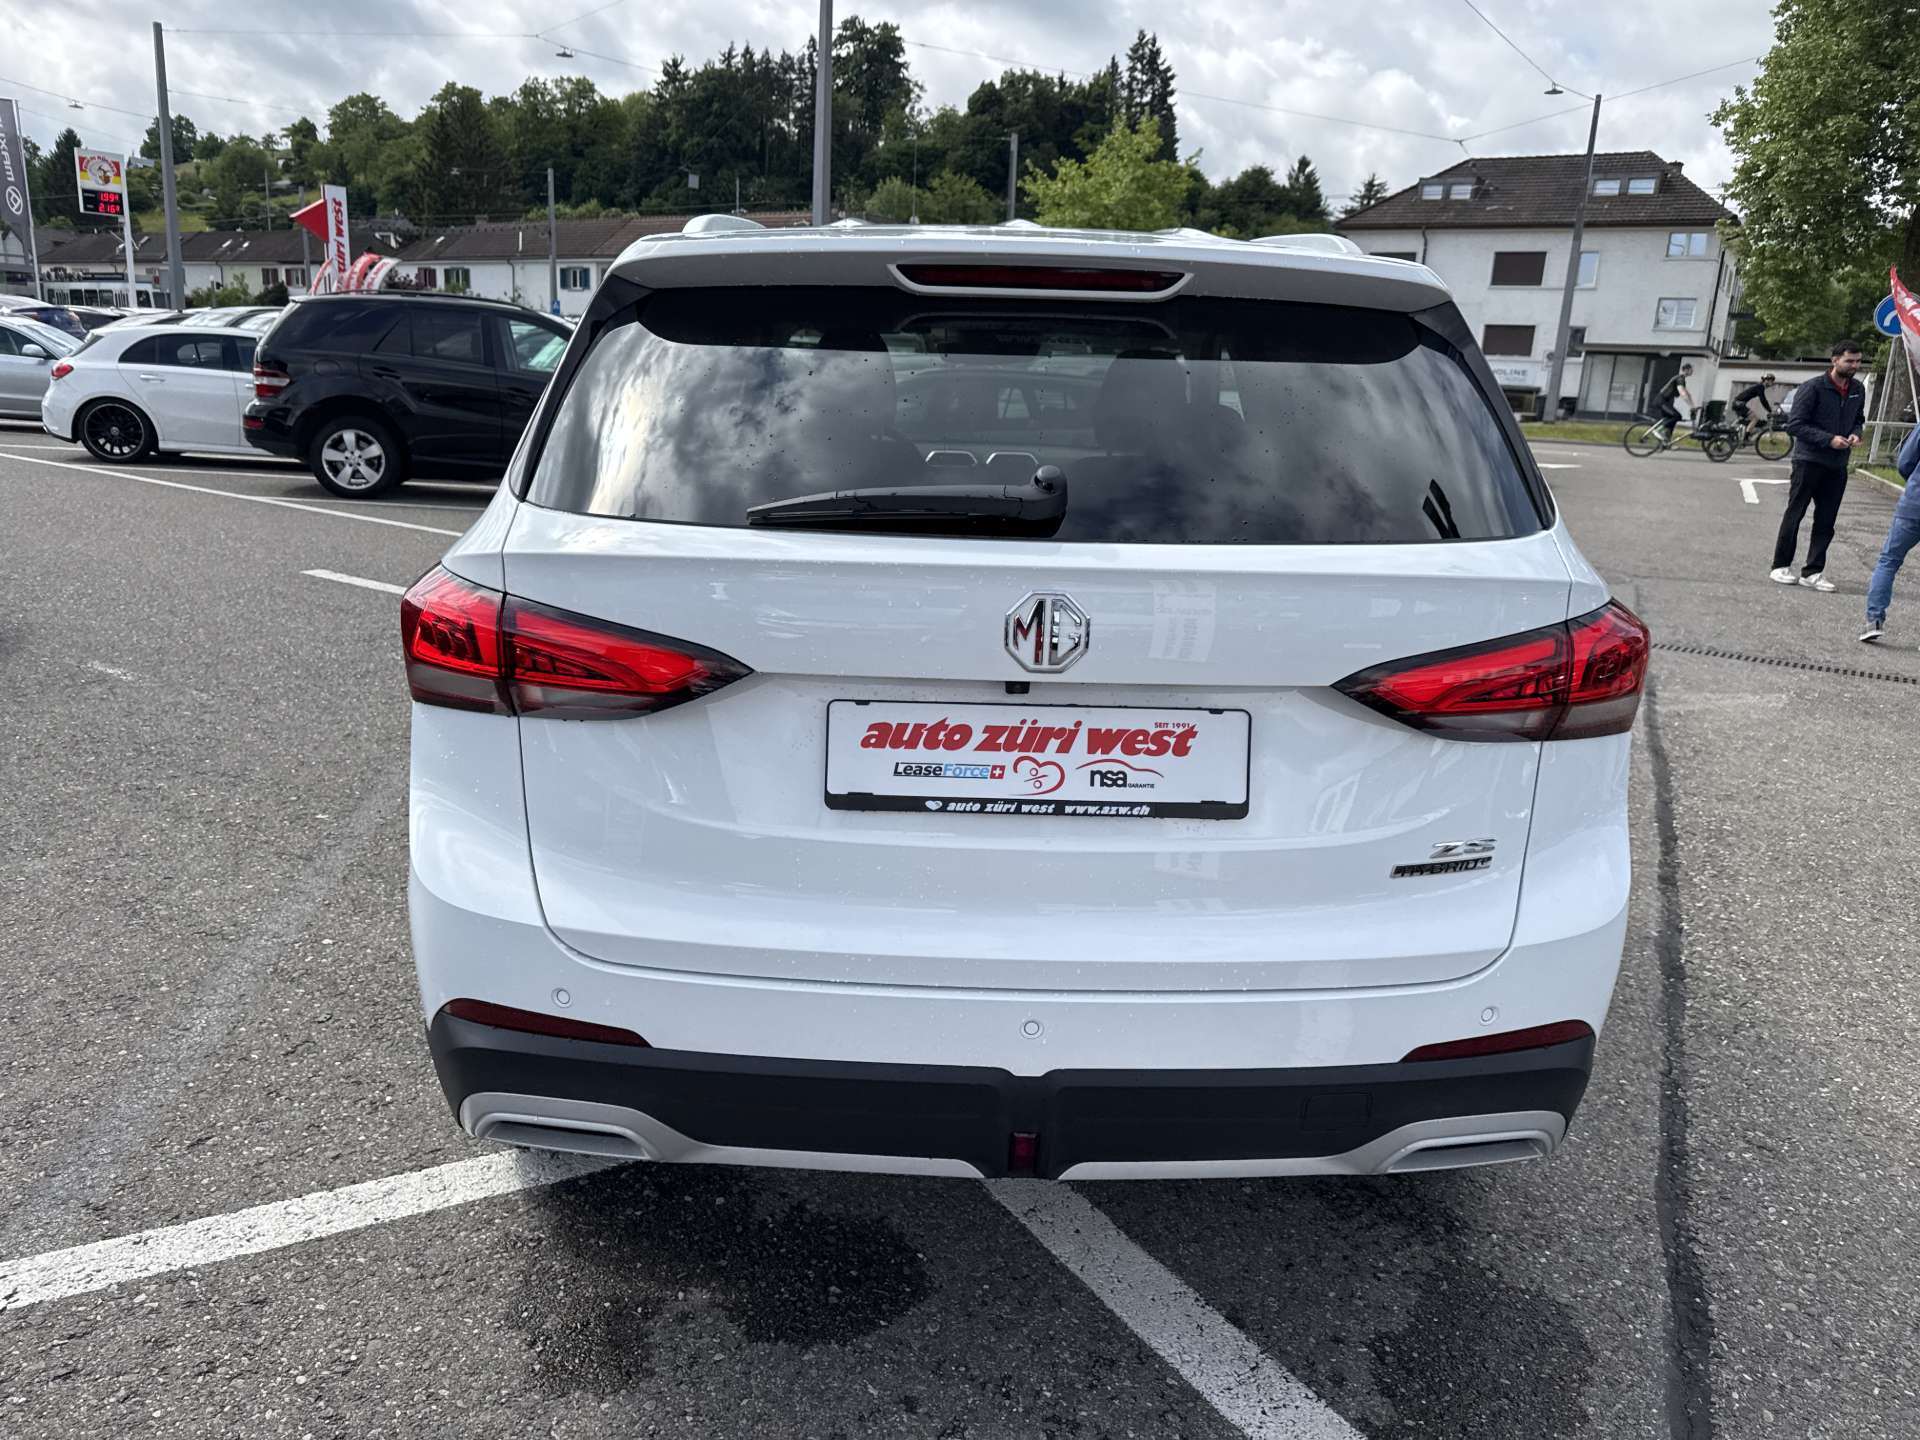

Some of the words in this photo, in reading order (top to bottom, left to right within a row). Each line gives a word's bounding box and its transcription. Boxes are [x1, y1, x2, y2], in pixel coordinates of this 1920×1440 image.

[332, 197, 345, 238] west
[1013, 599, 1082, 666] MG
[860, 717, 973, 751] auto
[974, 719, 1083, 754] züri
[1087, 724, 1199, 757] west
[1090, 769, 1127, 788] nsa
[946, 801, 981, 812] auto
[984, 801, 1018, 813] züri
[1021, 803, 1056, 814] west
[1064, 804, 1151, 816] www.azw.ch
[1430, 838, 1497, 859] ZS
